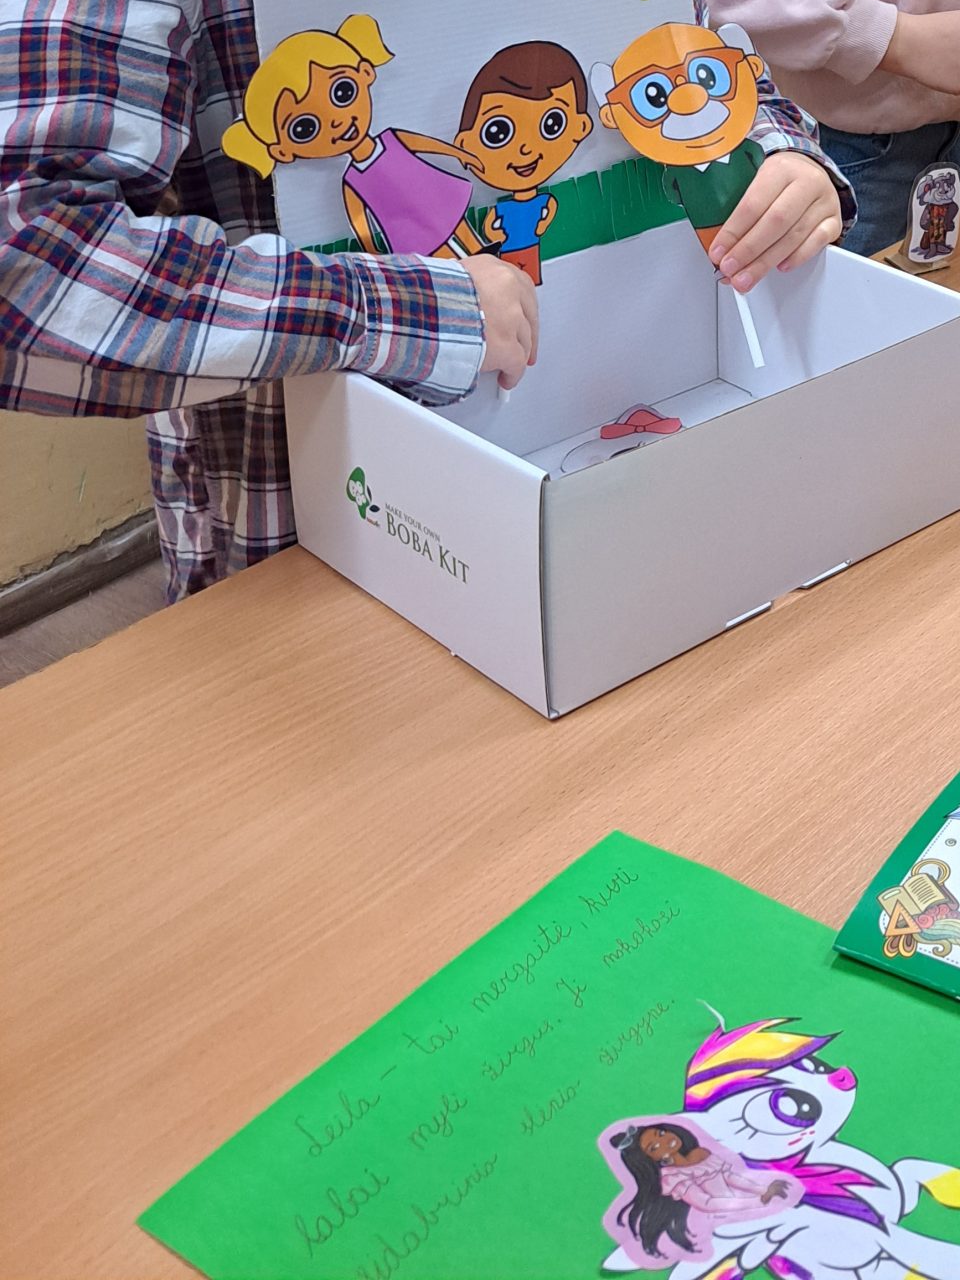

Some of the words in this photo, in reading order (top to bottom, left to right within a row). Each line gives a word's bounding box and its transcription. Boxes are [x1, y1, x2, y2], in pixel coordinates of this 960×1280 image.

[386, 511, 435, 563] BOBA
[439, 544, 470, 585] KIT
[295, 1091, 381, 1158] Leila
[402, 1020, 459, 1054] tai
[578, 867, 639, 916] kuri
[295, 1168, 390, 1259] labai
[408, 1093, 468, 1151] myli
